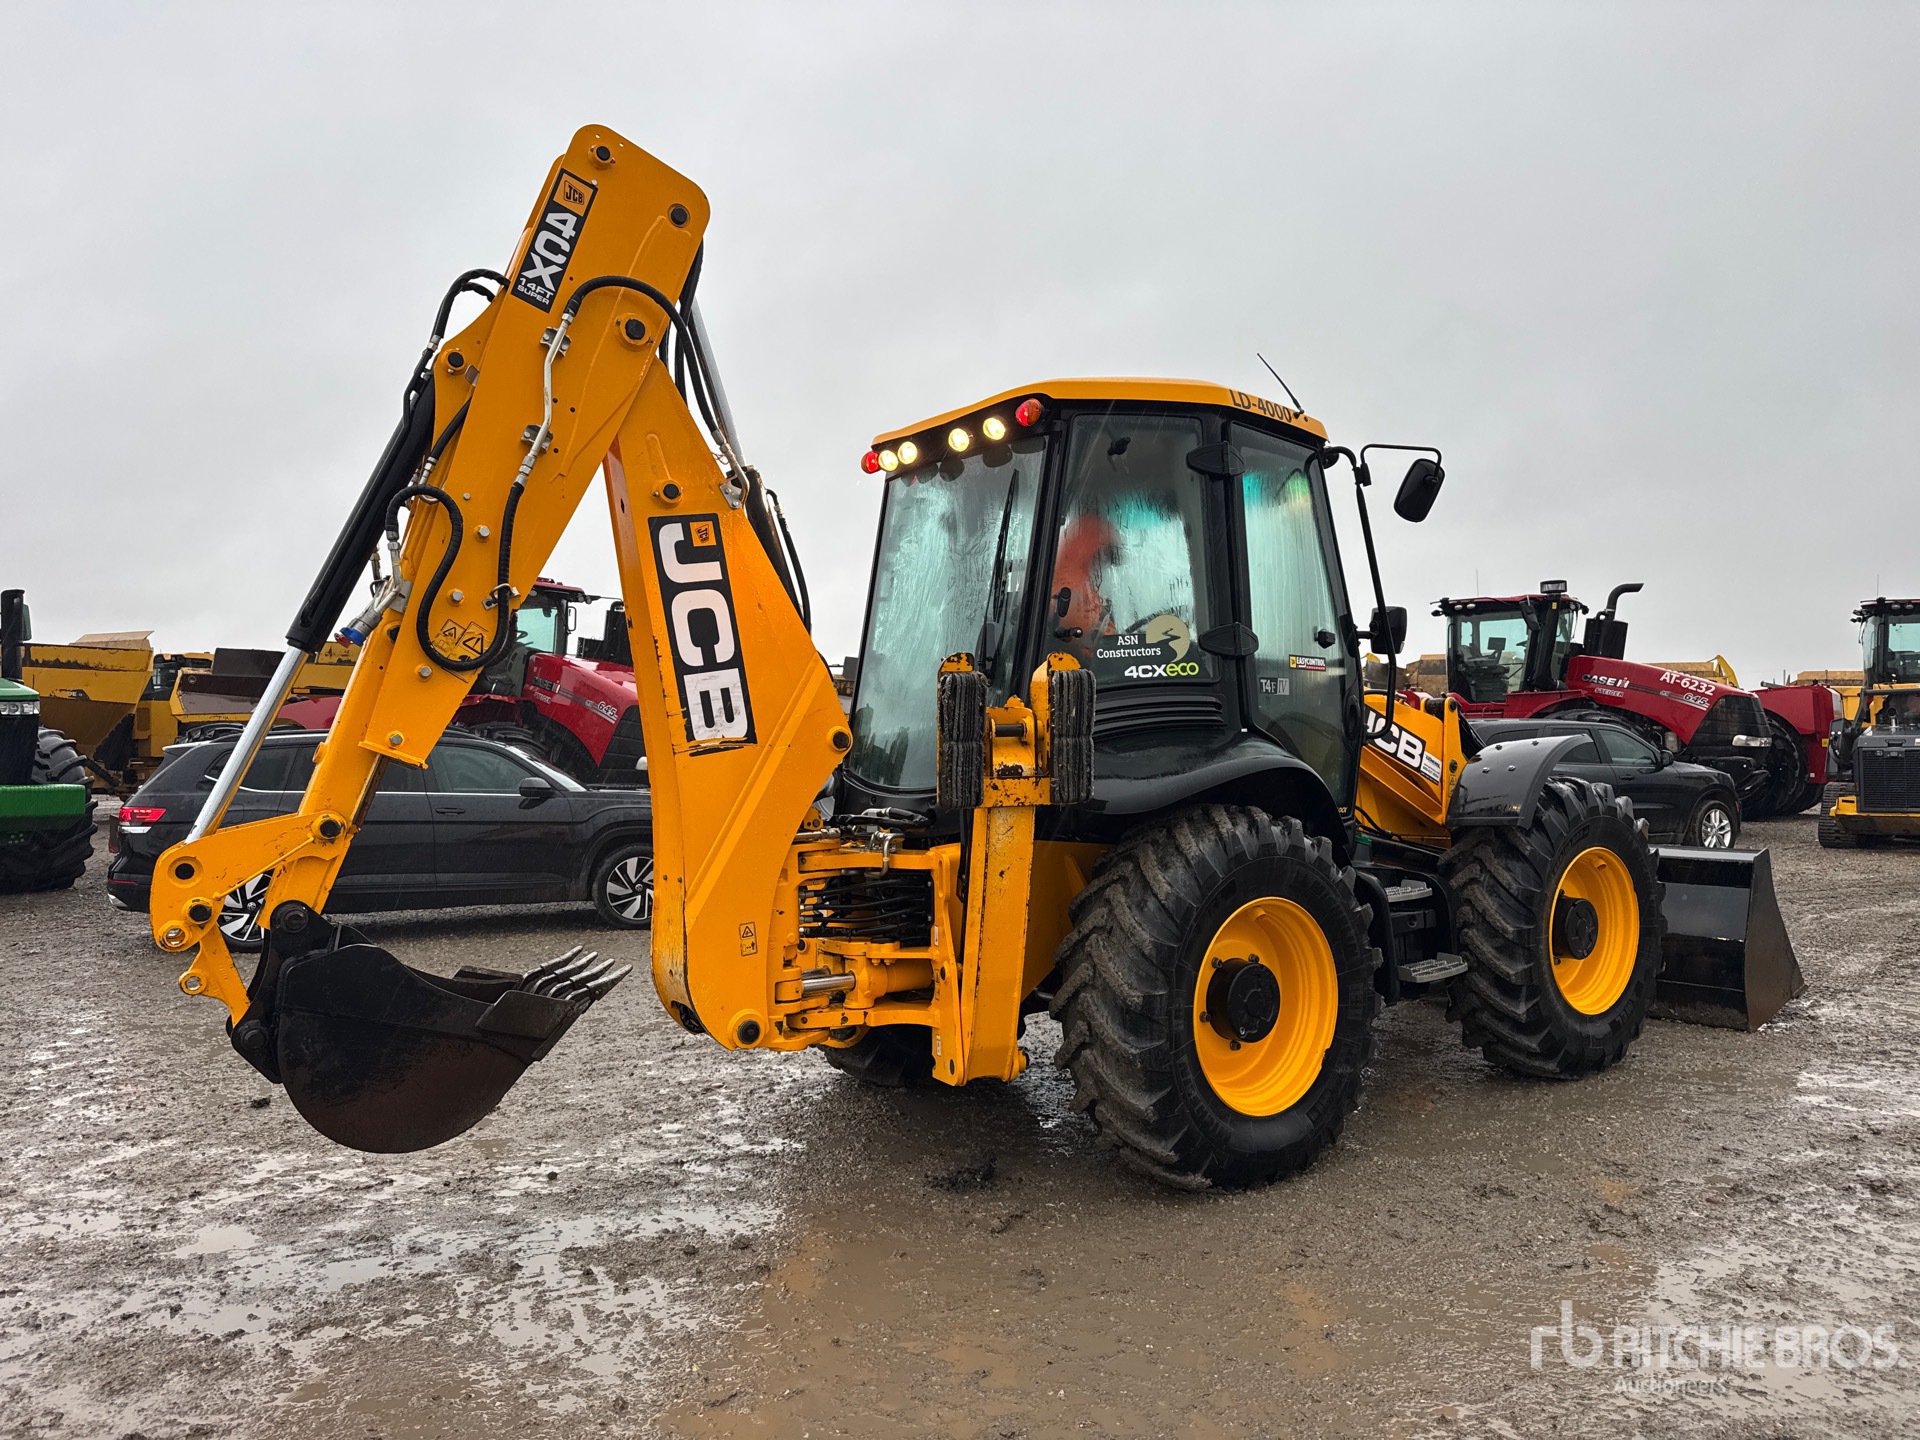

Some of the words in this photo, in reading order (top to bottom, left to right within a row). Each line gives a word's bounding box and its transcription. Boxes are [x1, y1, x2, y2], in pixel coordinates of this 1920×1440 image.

[565, 183, 583, 203] JCB
[521, 213, 578, 291] 4CX
[517, 285, 549, 305] SUPER
[520, 277, 553, 299] 14FT
[1228, 389, 1292, 423] LD-4000
[658, 522, 748, 741] JCB
[1117, 635, 1139, 646] ASN
[1096, 647, 1161, 659] Constructors
[1582, 674, 1617, 686] CASE
[1660, 671, 1716, 696] AT-6232
[598, 701, 617, 717] 645
[1684, 693, 1708, 706] 645
